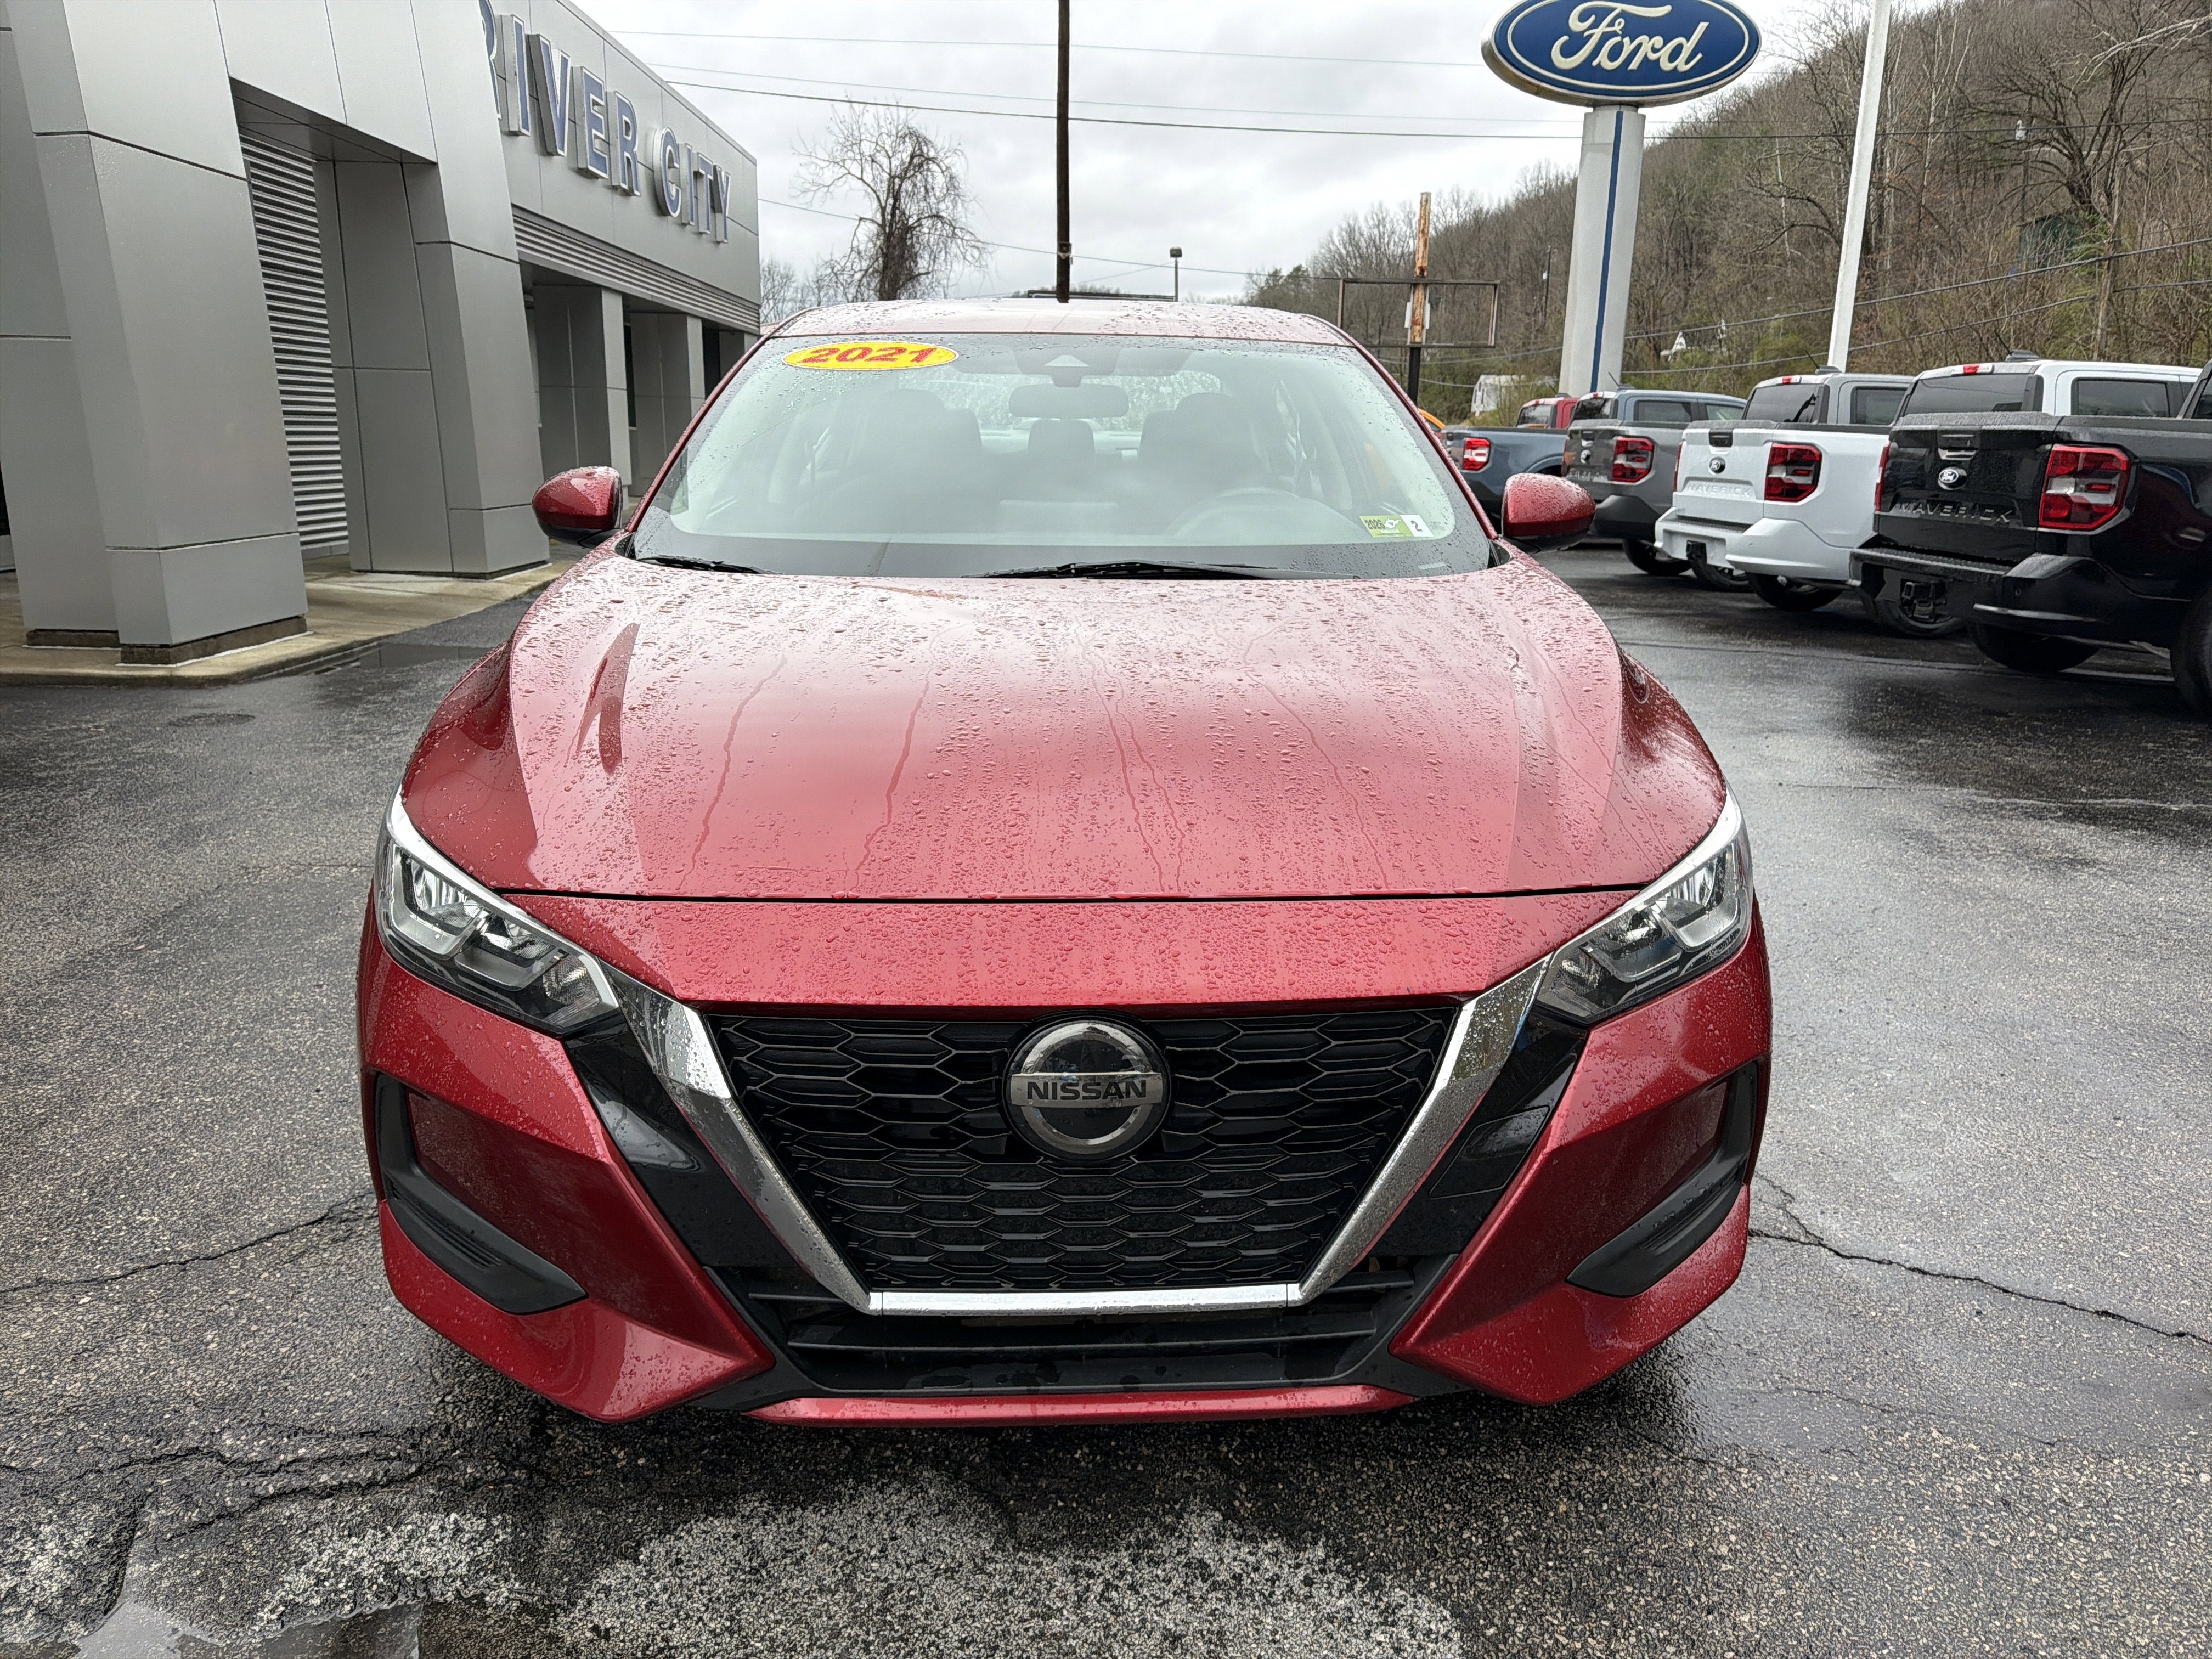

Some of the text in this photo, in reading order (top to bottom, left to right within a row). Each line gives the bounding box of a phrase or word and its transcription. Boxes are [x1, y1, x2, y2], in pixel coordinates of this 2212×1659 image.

[1551, 1, 1710, 72] Ford
[654, 127, 731, 243] CITY
[798, 347, 938, 363] 2021
[1688, 483, 1751, 498] MAVERICK
[1899, 501, 2012, 522] MAVERICK
[1364, 519, 1386, 530] 2026
[1410, 520, 1424, 532] 2
[1027, 1079, 1147, 1101] NISSAN
